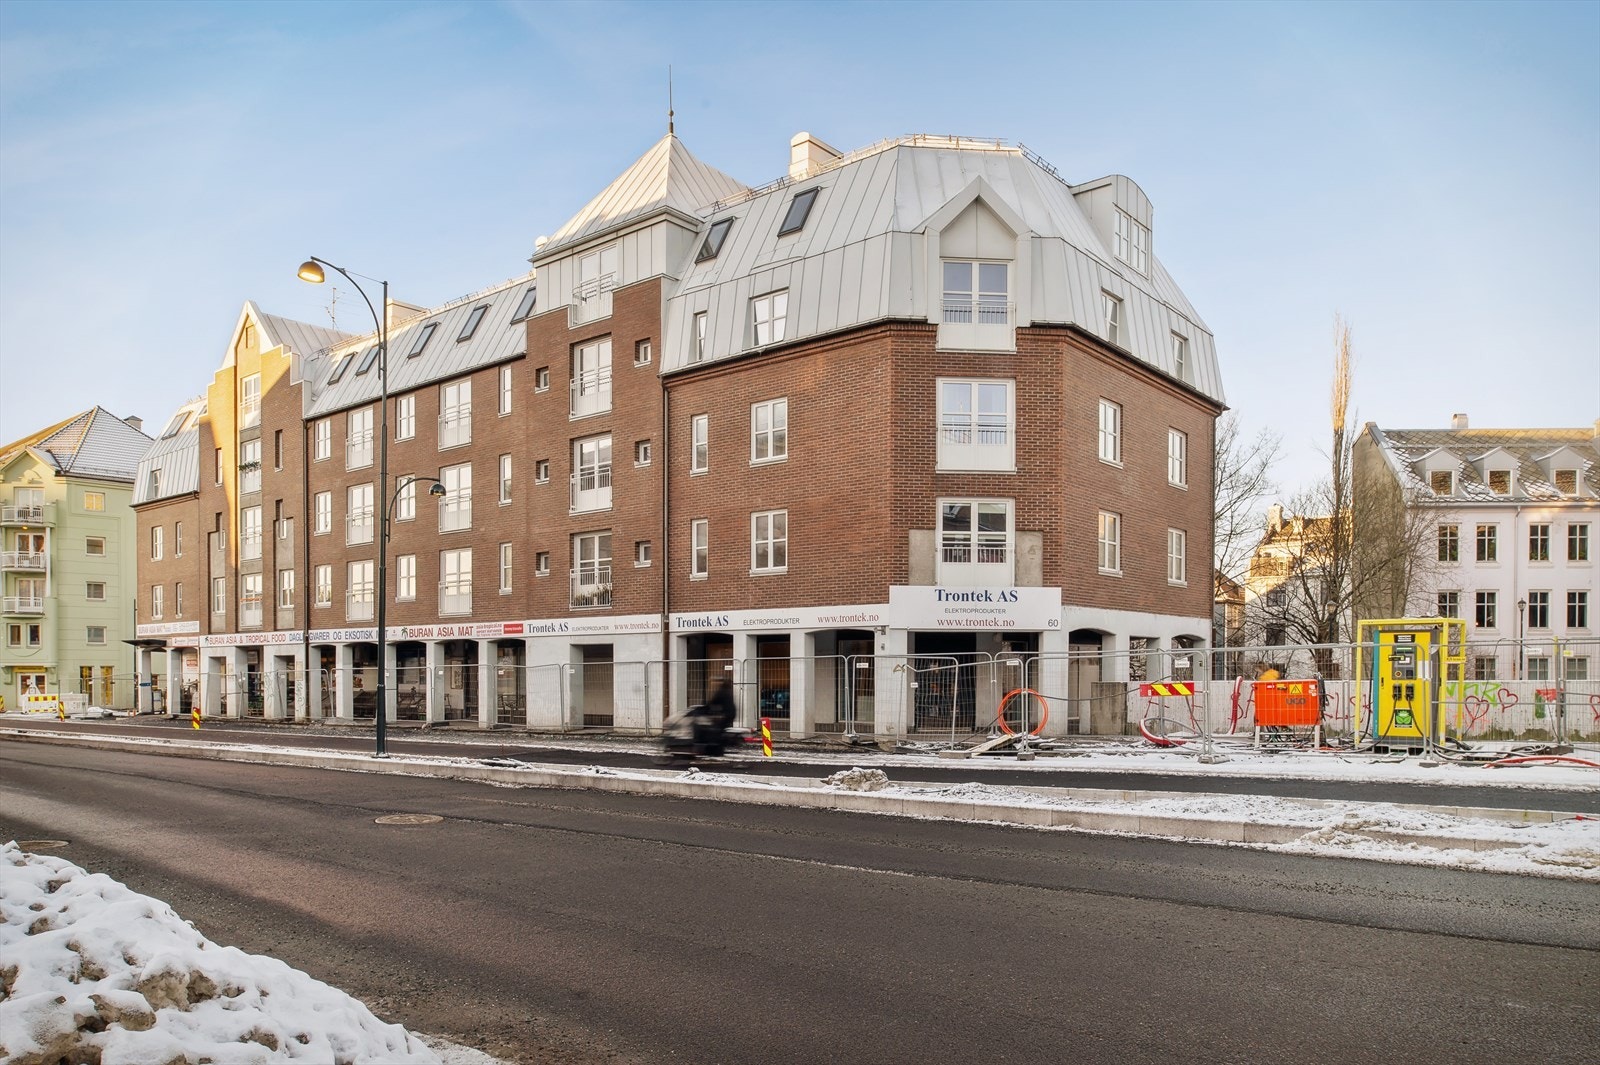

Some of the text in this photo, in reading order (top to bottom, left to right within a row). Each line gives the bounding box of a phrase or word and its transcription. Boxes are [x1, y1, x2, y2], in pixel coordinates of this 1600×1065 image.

[934, 588, 1018, 603] Trontek AS
[527, 622, 556, 634] Trontek
[558, 621, 569, 633] AS
[613, 620, 660, 631] www.trontek.no
[676, 612, 879, 628] Trontek AS ELEKTROPRODUKTER www.trontek.no
[936, 617, 1015, 627] www.trontek.no
[1047, 618, 1059, 628] 60
[209, 634, 225, 645] BURAN
[226, 634, 237, 644] ASIA
[239, 634, 244, 644] &
[245, 633, 270, 643] TROPICAL
[271, 633, 287, 643] FOOD
[332, 630, 342, 641] OG
[344, 629, 374, 640] EKSOTISK
[408, 627, 434, 638] BURAN
[436, 626, 455, 638] ASIA
[457, 625, 474, 637] MAT
